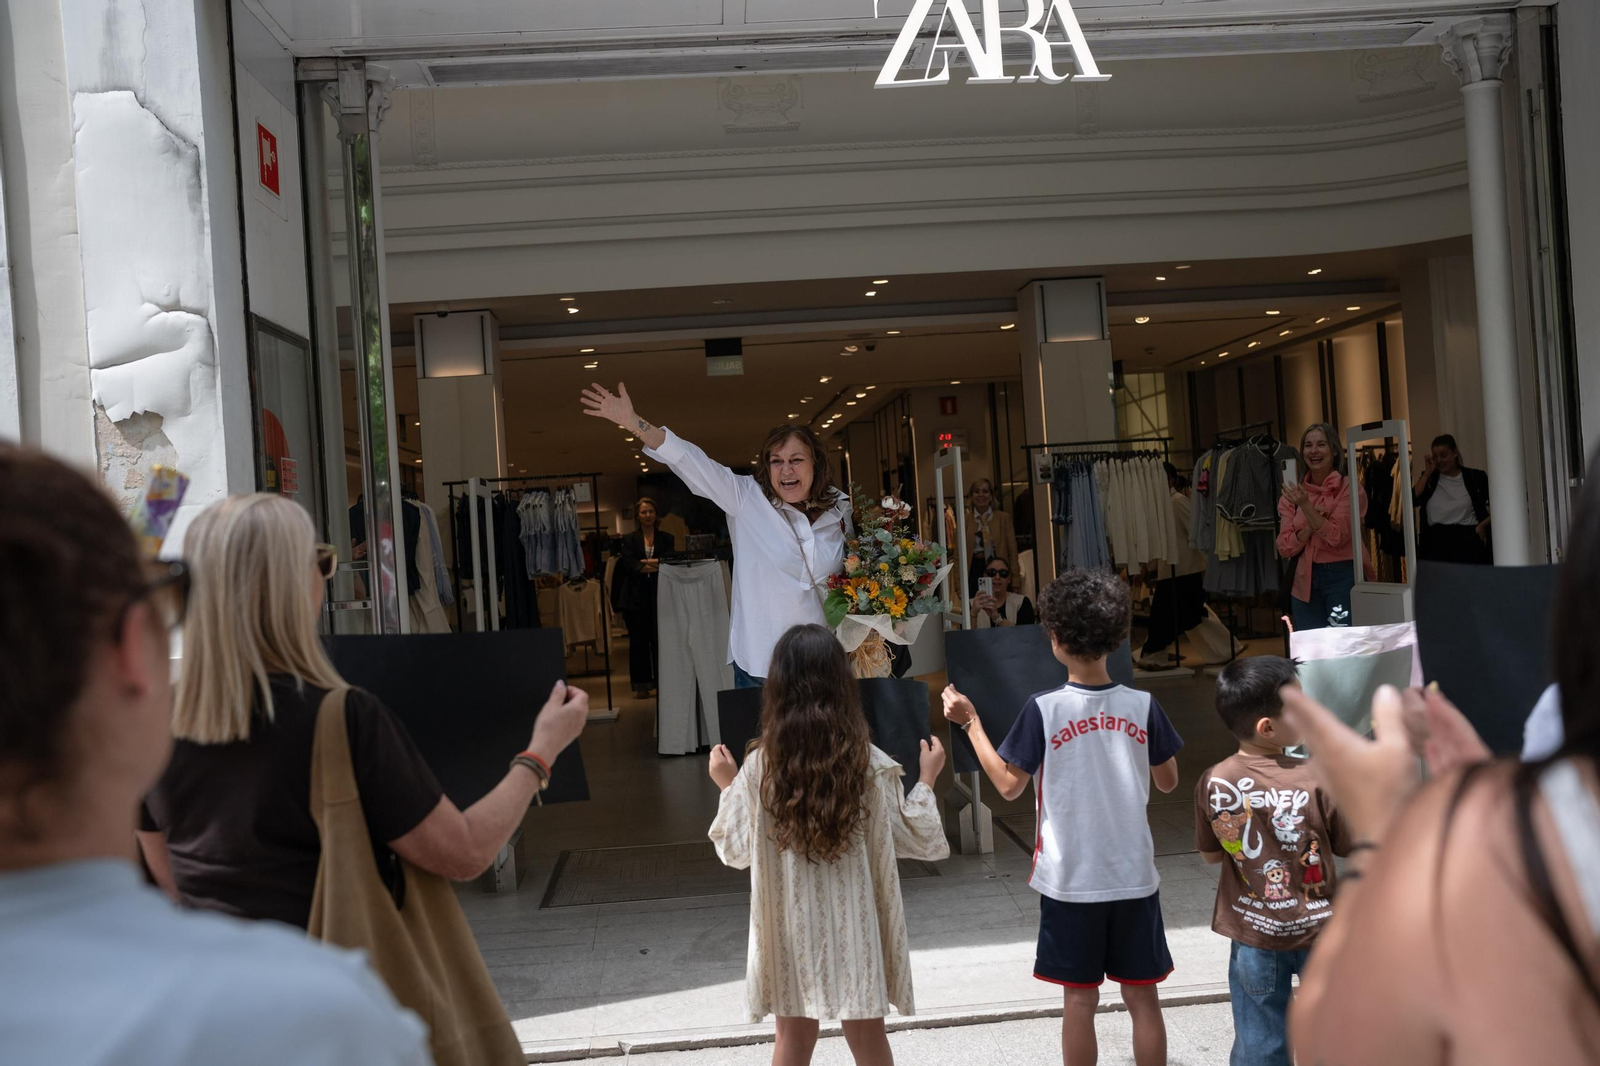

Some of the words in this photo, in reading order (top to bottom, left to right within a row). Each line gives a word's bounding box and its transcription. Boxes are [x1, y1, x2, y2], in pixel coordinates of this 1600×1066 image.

[873, 0, 1113, 89] ZARA
[1051, 711, 1148, 750] salesianos
[1280, 844, 1298, 852] PUA
